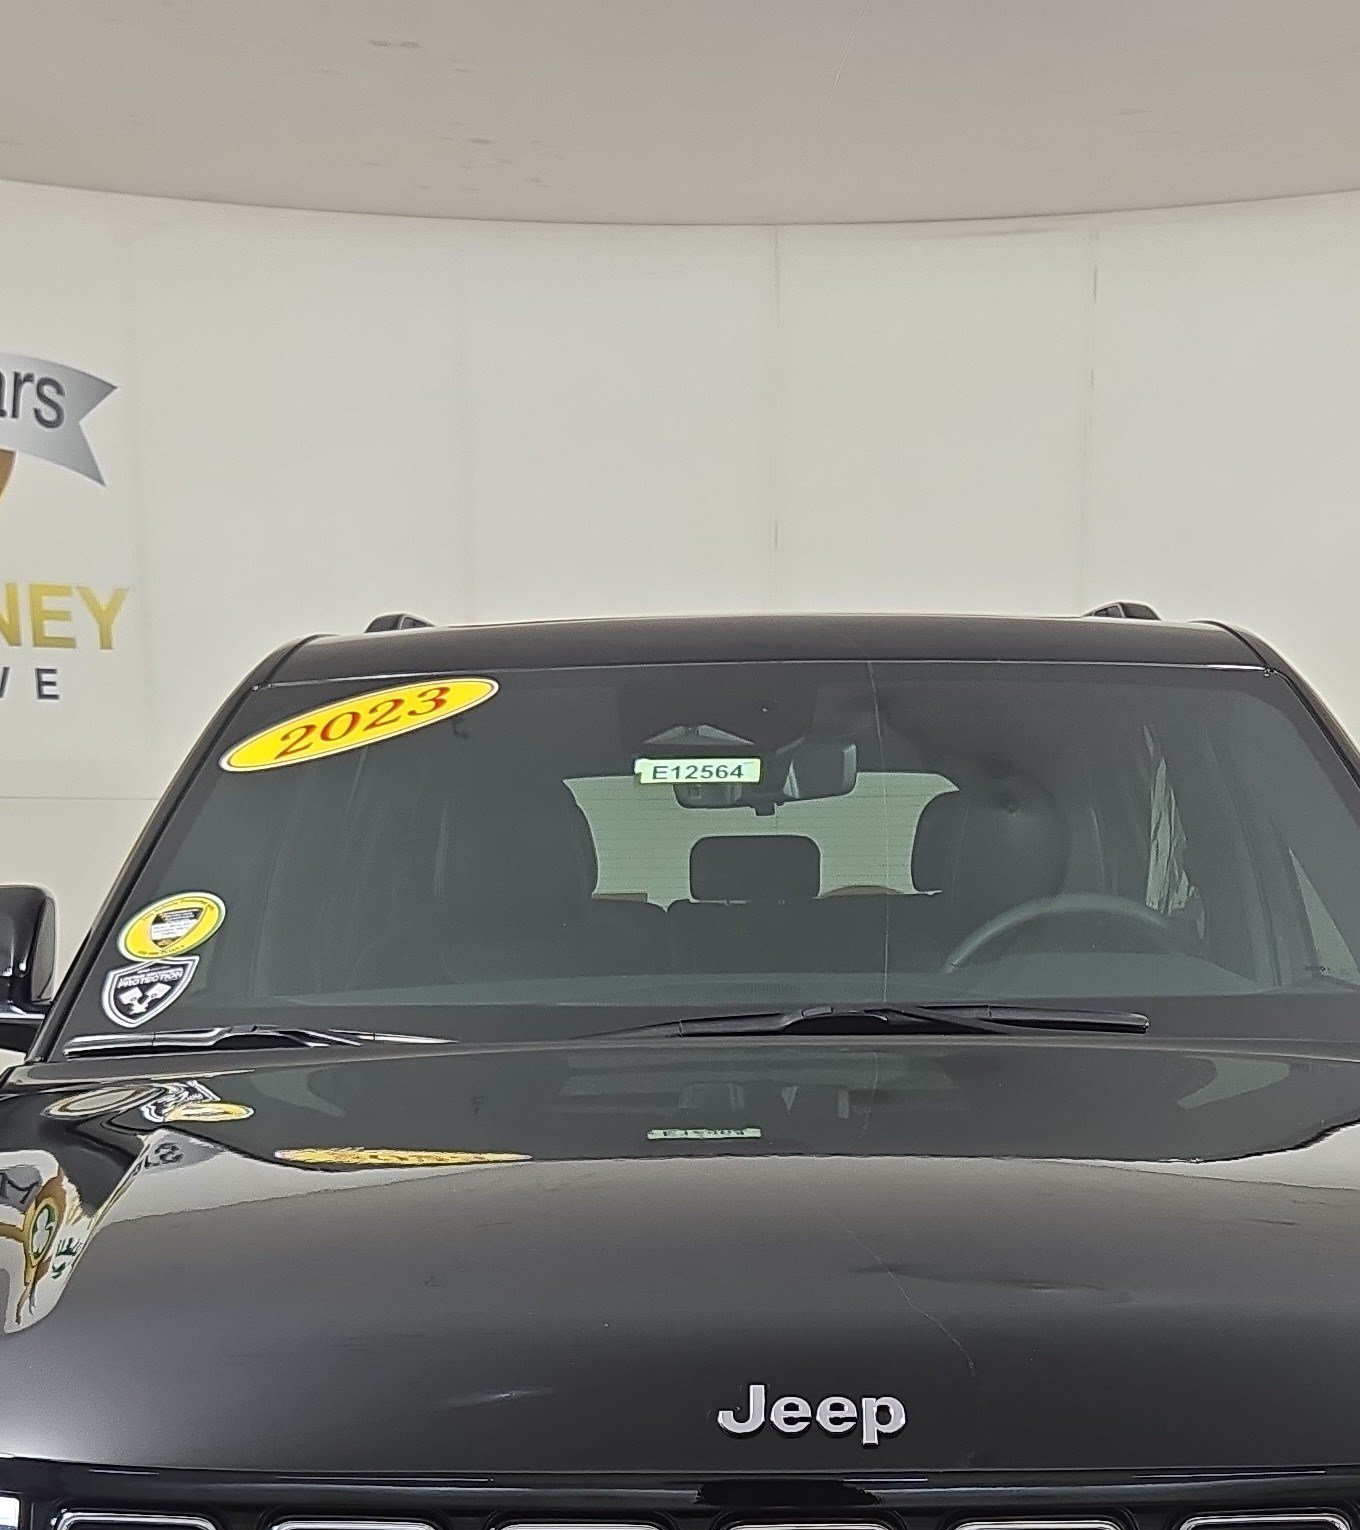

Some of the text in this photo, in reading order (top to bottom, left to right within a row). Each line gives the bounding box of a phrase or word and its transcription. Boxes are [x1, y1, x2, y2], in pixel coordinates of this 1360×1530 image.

[274, 686, 451, 760] 2023
[652, 764, 744, 780] E12564
[717, 1384, 906, 1446] Jeep
